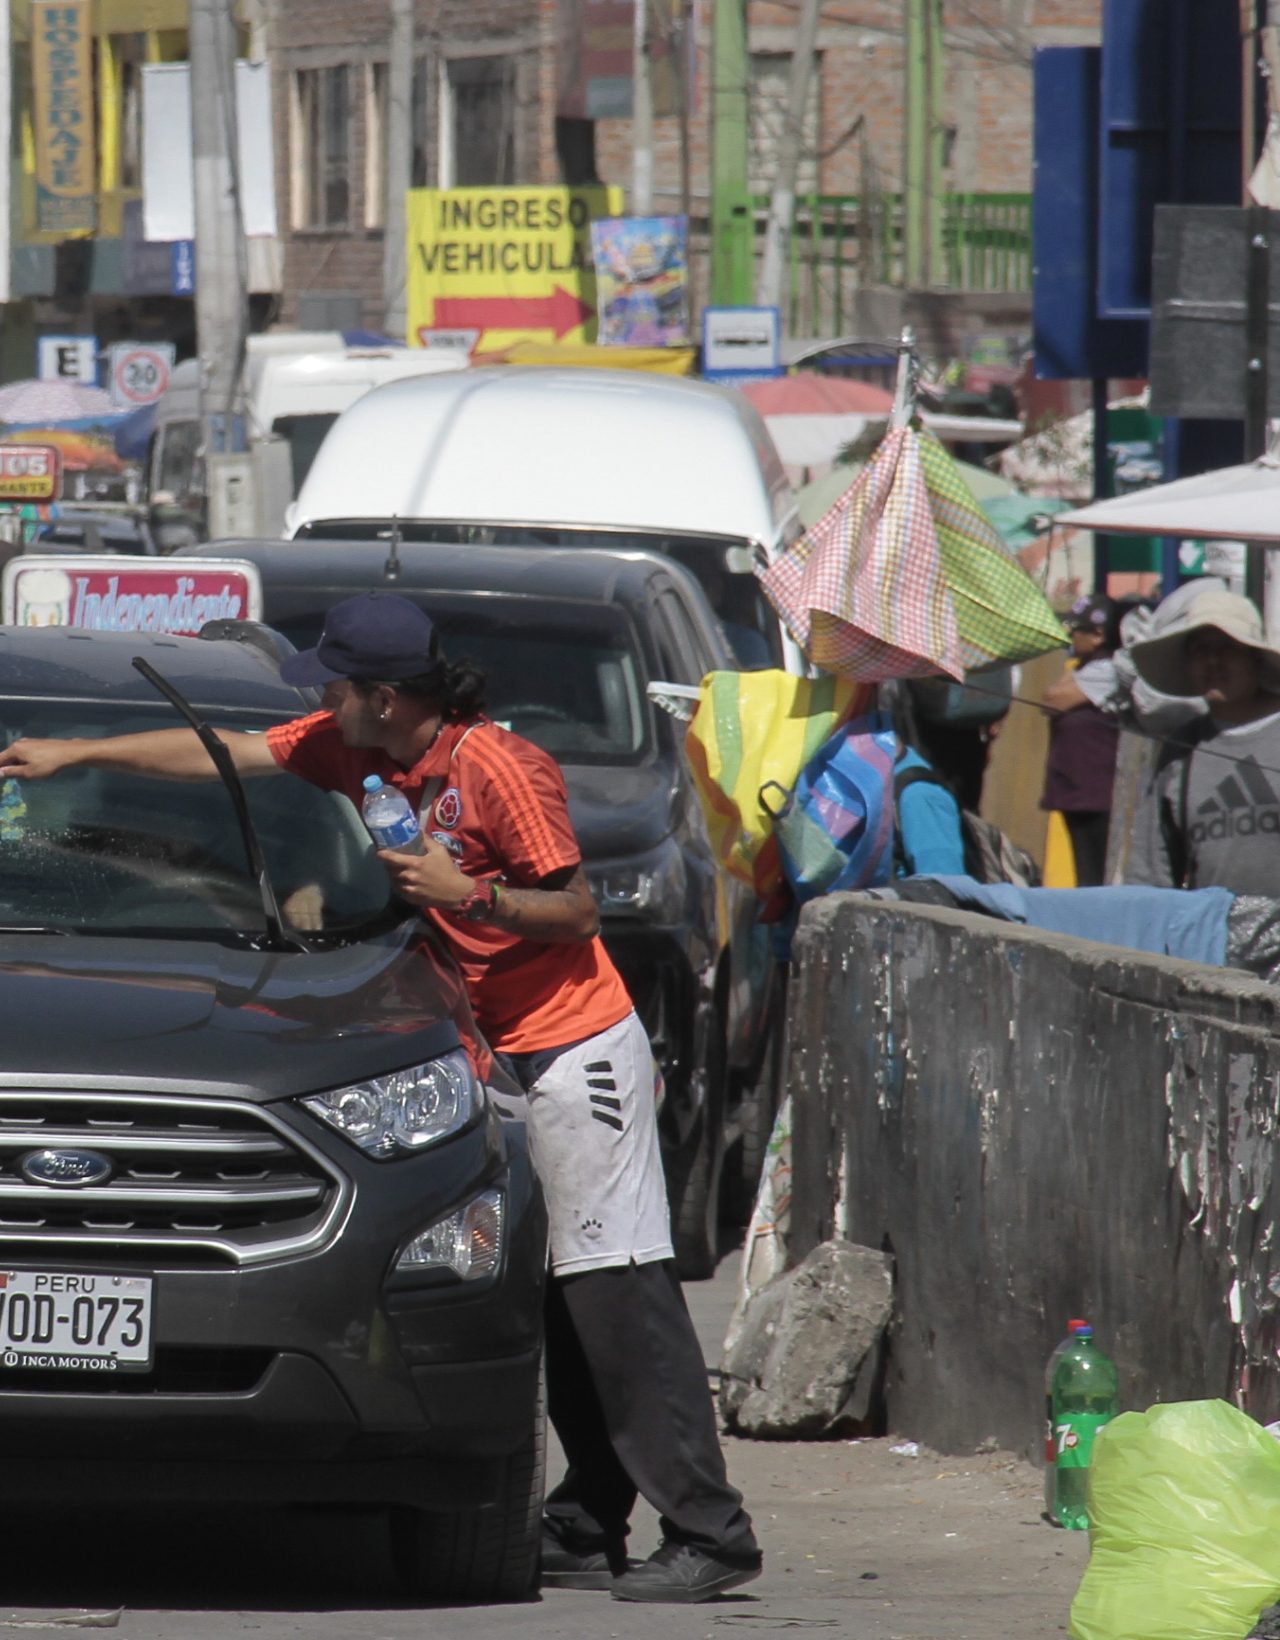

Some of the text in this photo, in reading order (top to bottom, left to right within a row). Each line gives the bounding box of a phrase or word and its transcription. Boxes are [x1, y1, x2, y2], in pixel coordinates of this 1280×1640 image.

[43, 8, 84, 188] HOSPEDAJE
[440, 199, 589, 229] INGRESO
[419, 242, 596, 272] VEHICULA
[57, 347, 79, 377] E
[74, 576, 241, 634] Independiente
[1190, 806, 1280, 843] adida
[43, 1153, 90, 1176] Ford
[34, 1275, 96, 1293] PERU
